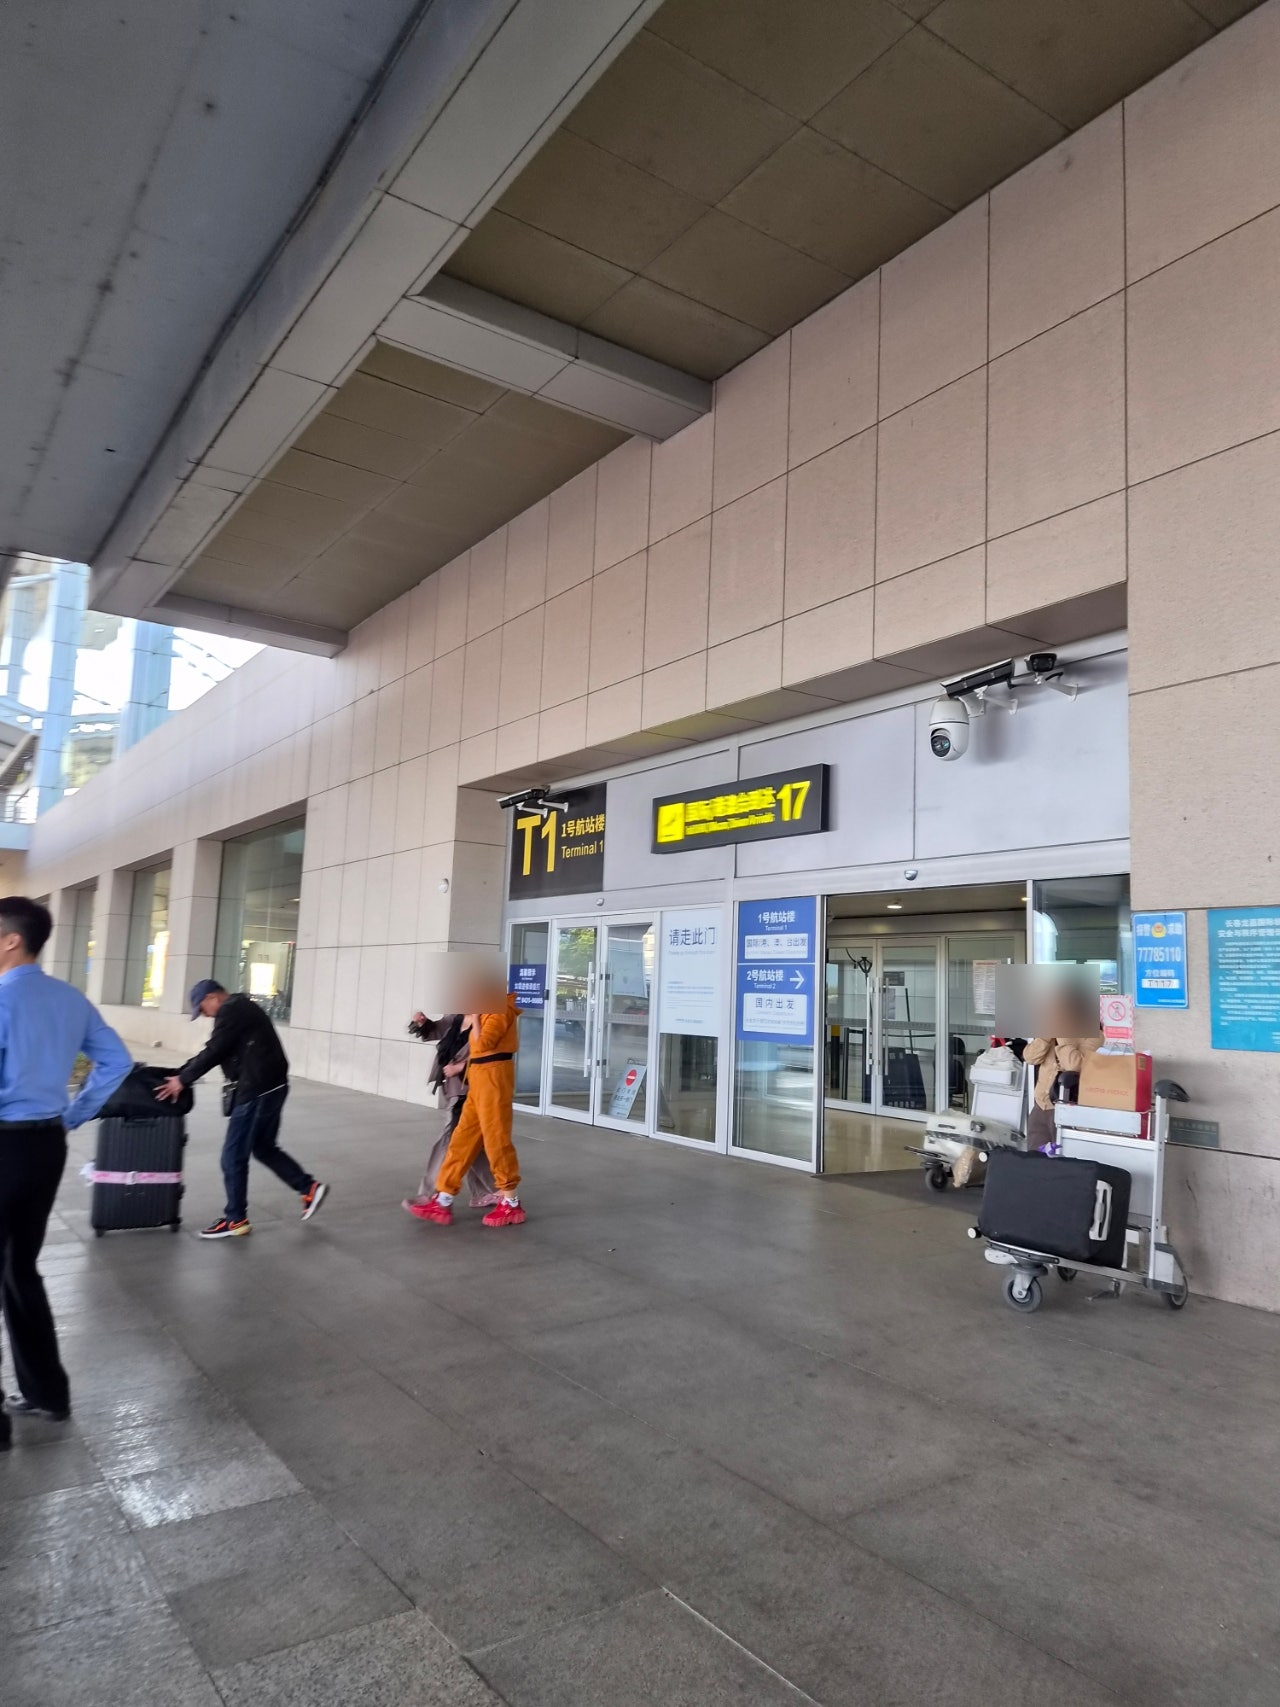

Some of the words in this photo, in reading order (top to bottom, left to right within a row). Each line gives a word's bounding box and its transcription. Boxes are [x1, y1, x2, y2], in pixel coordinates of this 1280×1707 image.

[777, 781, 811, 821] 17
[561, 814, 605, 837] 1号航站楼
[517, 811, 557, 876] T1
[561, 841, 597, 859] Terminal
[599, 840, 604, 853] 1
[758, 911, 796, 923] 1号航站楼
[669, 927, 716, 946] 请走此门
[1137, 946, 1182, 962] 77785110
[747, 969, 784, 982] 2号航站楼
[756, 997, 795, 1010] 国内出发
